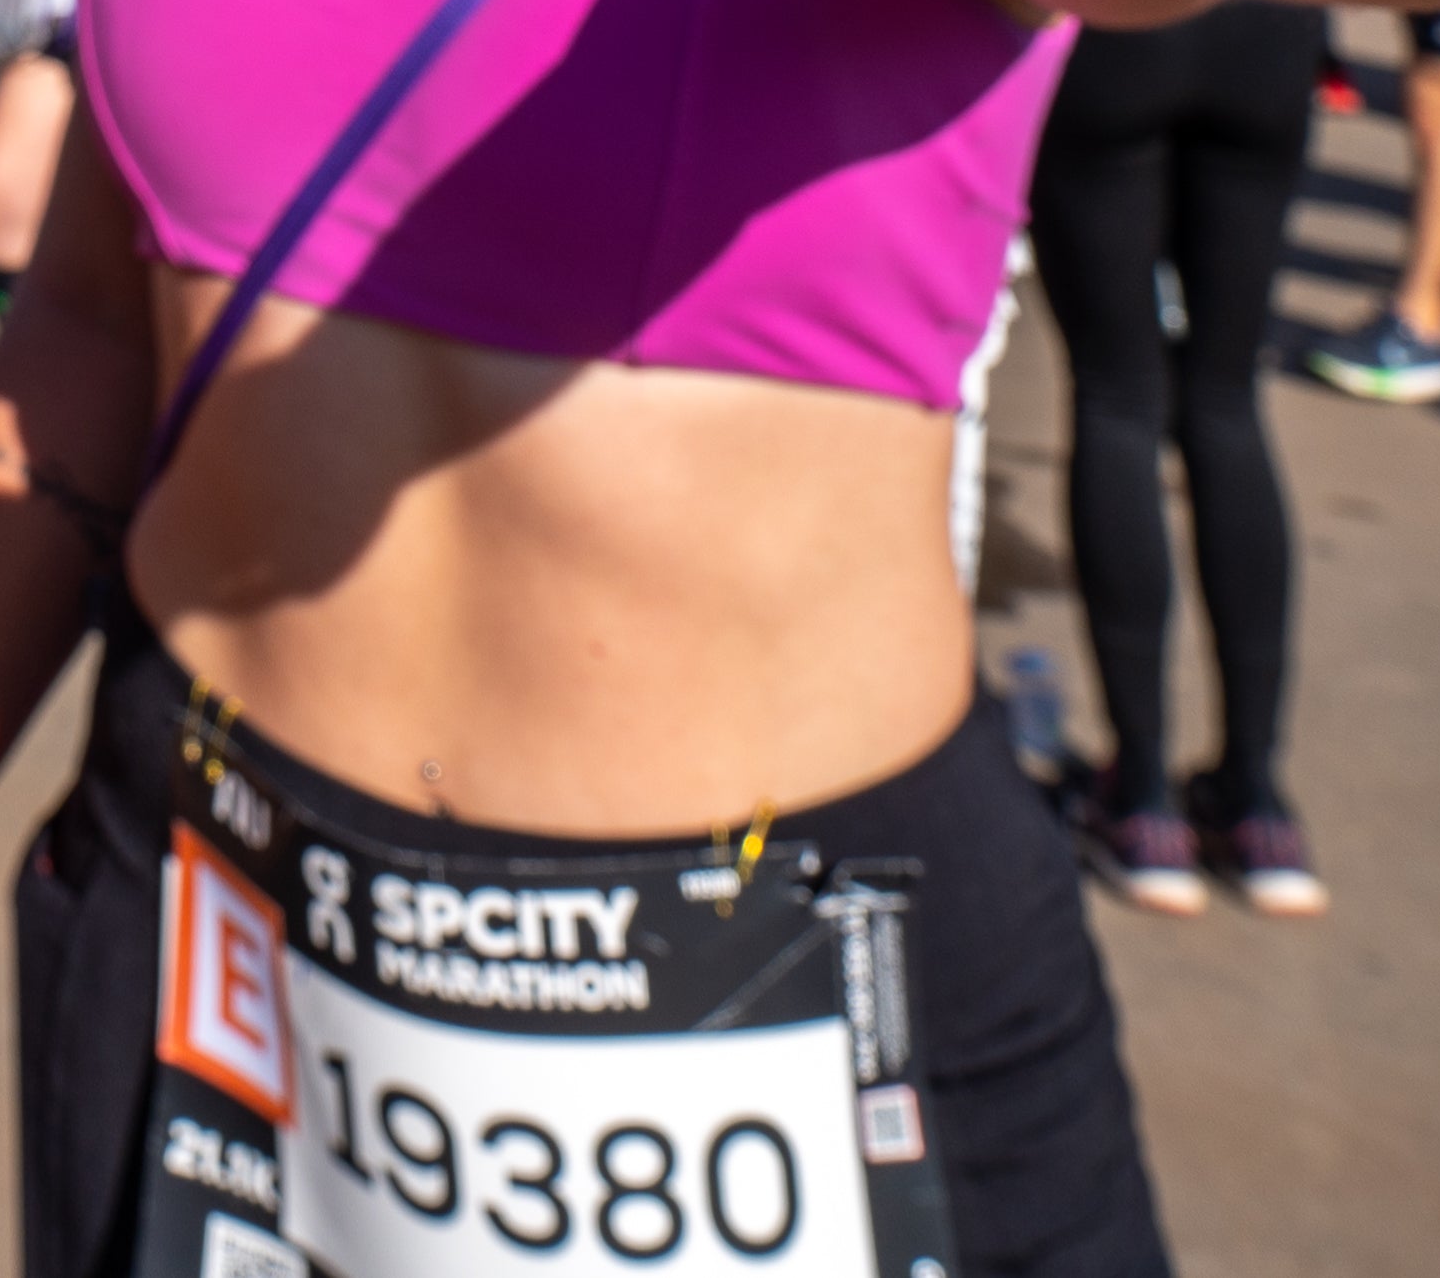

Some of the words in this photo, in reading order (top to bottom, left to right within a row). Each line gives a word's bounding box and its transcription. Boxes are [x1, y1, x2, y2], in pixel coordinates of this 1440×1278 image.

[370, 872, 639, 959] SPCITY
[220, 912, 269, 1052] E
[374, 939, 650, 1013] MARATHON
[320, 1049, 803, 1258] 19380
